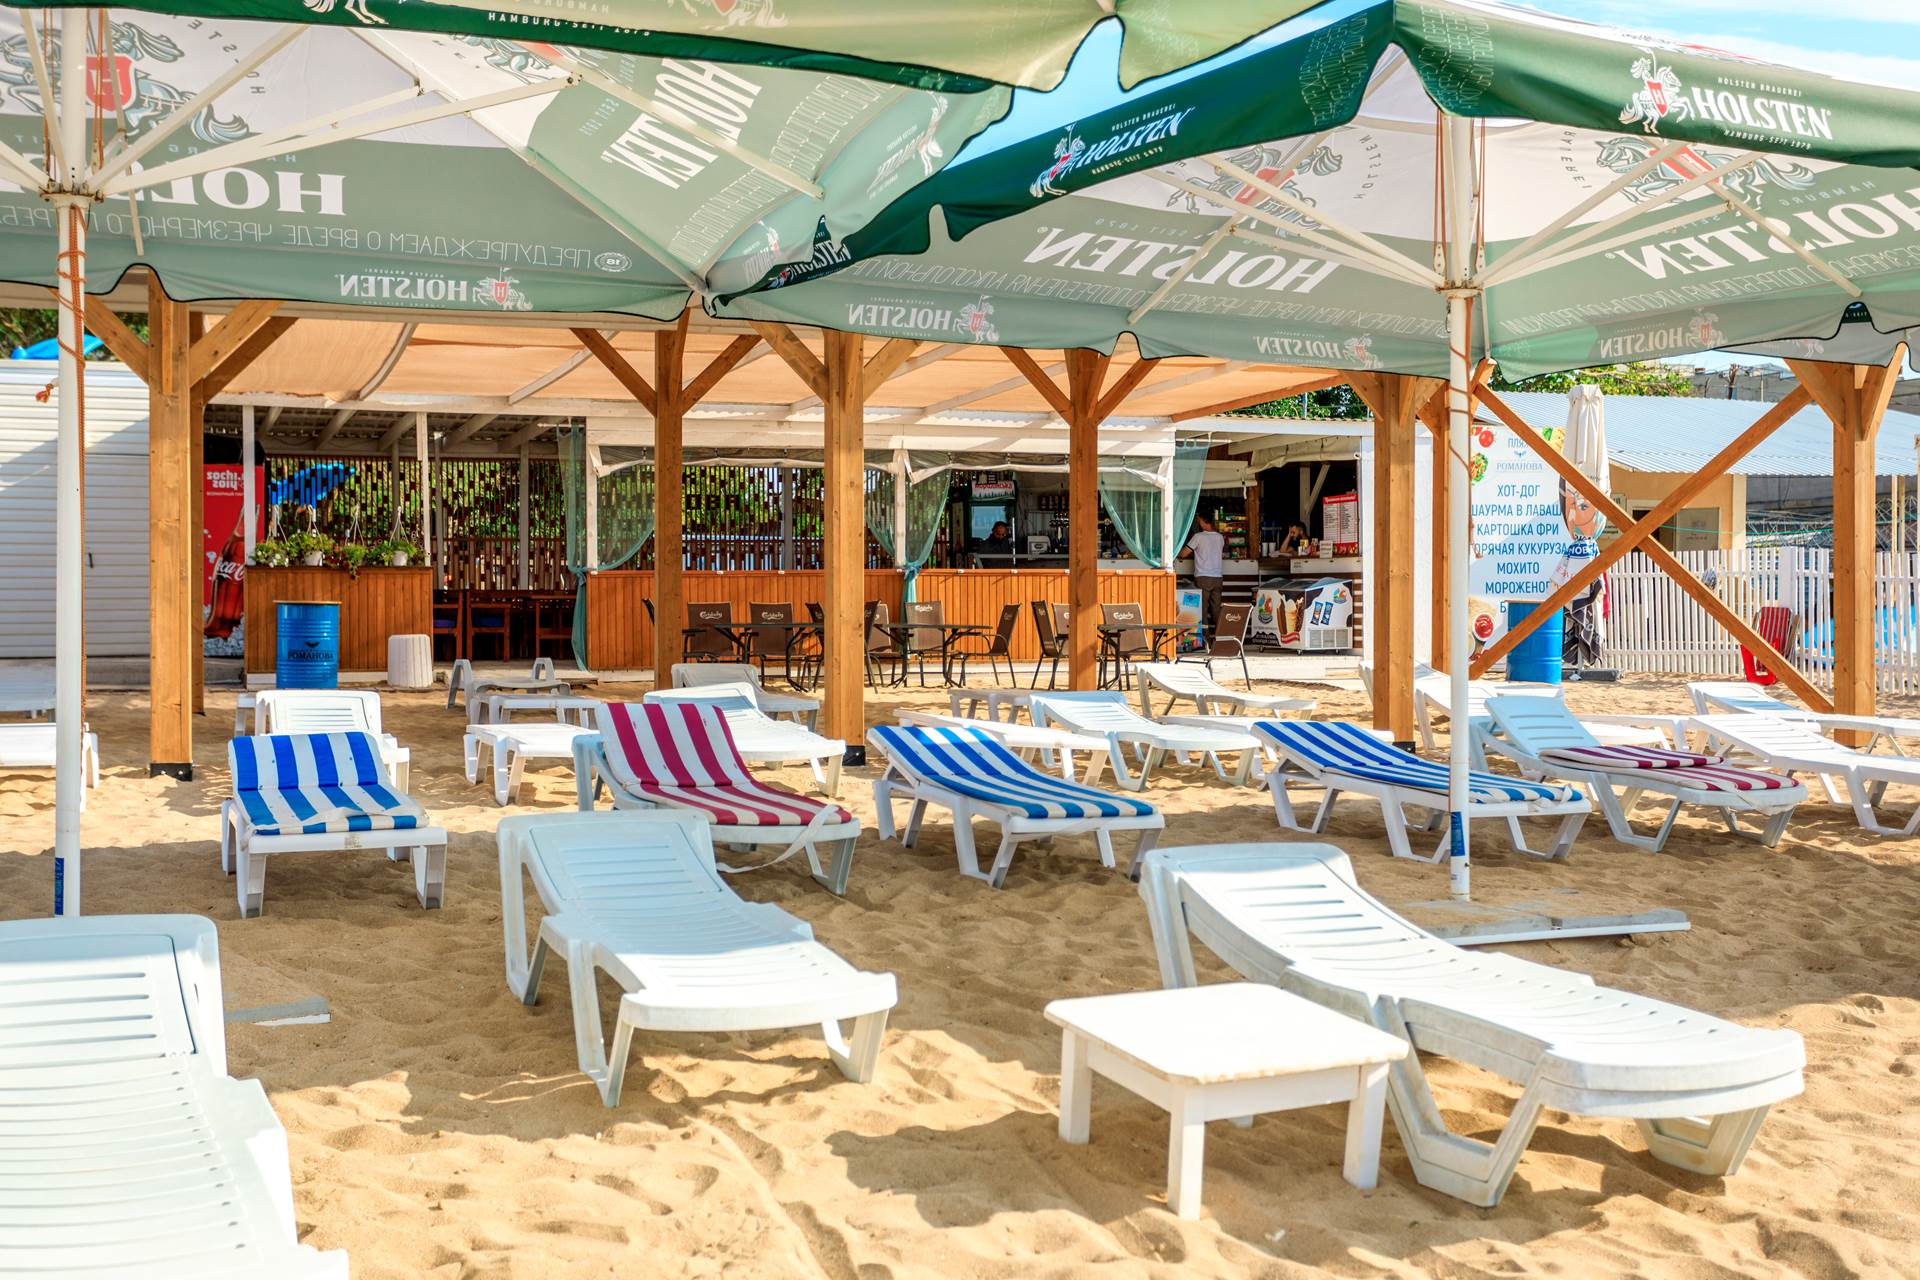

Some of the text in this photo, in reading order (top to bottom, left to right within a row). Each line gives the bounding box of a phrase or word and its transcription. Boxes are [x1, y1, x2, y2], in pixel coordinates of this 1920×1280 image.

[1718, 76, 1802, 97] HOLSTEN BRAUEREI
[1690, 87, 1833, 140] HOLSTEN
[1111, 116, 1140, 131] HOLSTEN
[1076, 110, 1188, 168] HOLSTEN
[1508, 437, 1529, 449] ПЛЯ
[1497, 462, 1543, 471] РОМАНОВА
[1497, 485, 1540, 499] ХОТ-ДОГ
[1516, 504, 1523, 516] В
[1526, 504, 1562, 517] ЛАВАШ
[1477, 522, 1559, 536] КАРТОШКА ФРИ
[1518, 542, 1568, 556] КУКУРУЗА
[1497, 562, 1540, 575] МОХИТО
[700, 611, 722, 619] Carlsberg
[761, 611, 784, 620] Carlsberg
[1113, 612, 1134, 620] Carlsberg
